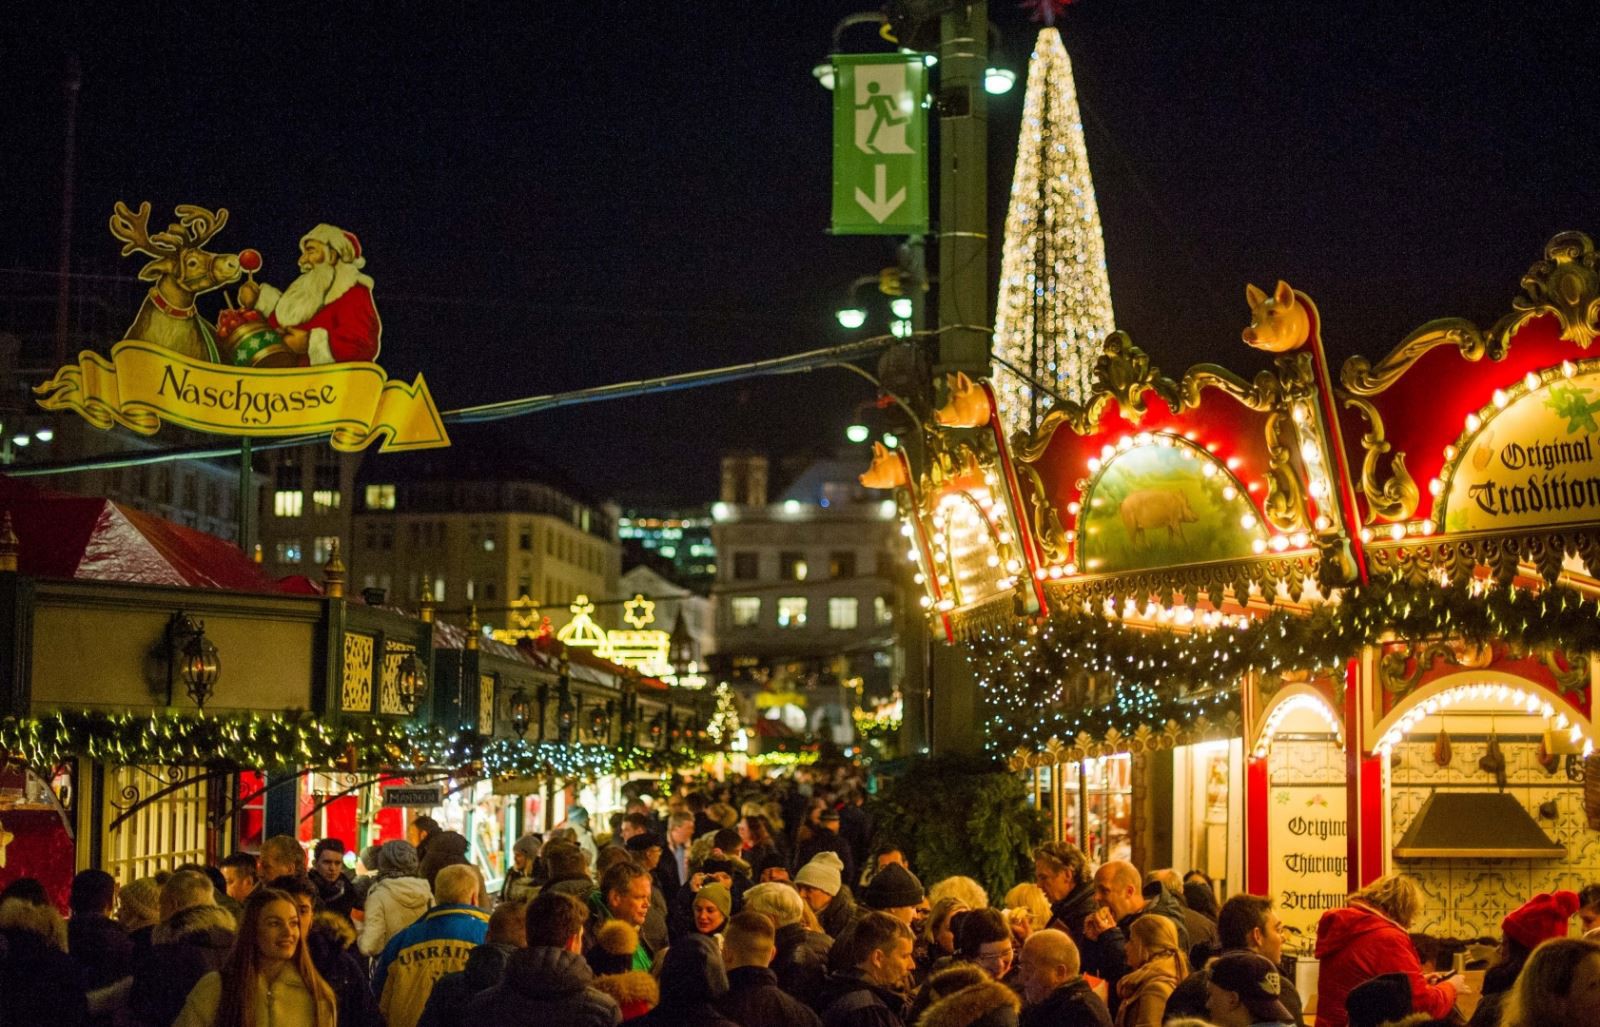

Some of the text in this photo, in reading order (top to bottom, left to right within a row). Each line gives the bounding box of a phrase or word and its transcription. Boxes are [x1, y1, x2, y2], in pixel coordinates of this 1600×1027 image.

[157, 364, 337, 424] Naschgasse
[1500, 434, 1593, 470] Original
[1288, 816, 1347, 840] Origin
[1283, 853, 1347, 878] Thüringe
[400, 945, 471, 965] UKRAIN
